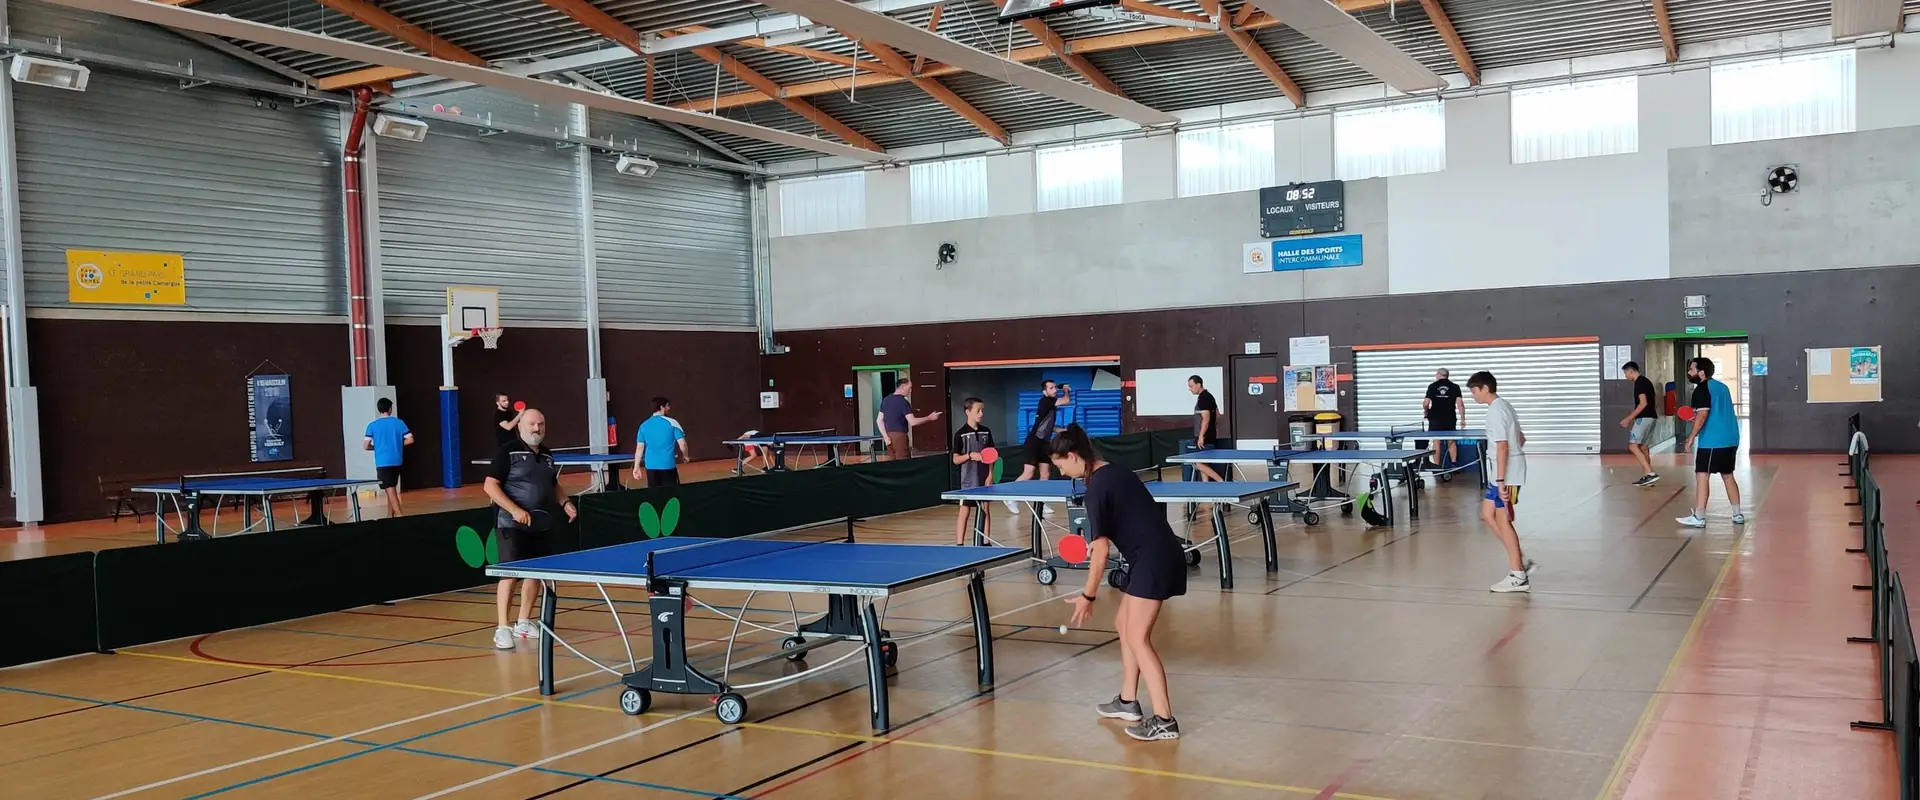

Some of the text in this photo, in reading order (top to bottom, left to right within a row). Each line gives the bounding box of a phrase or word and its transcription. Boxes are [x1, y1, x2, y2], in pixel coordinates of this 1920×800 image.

[1266, 205, 1294, 215] LOCAUX
[1305, 201, 1340, 211] VISITEURS
[1278, 246, 1343, 258] HALLE DES SPORTS
[1278, 254, 1341, 264] INTERCOMMUNALE
[121, 270, 147, 278] GRAND
[250, 430, 258, 462] CHAMPION
